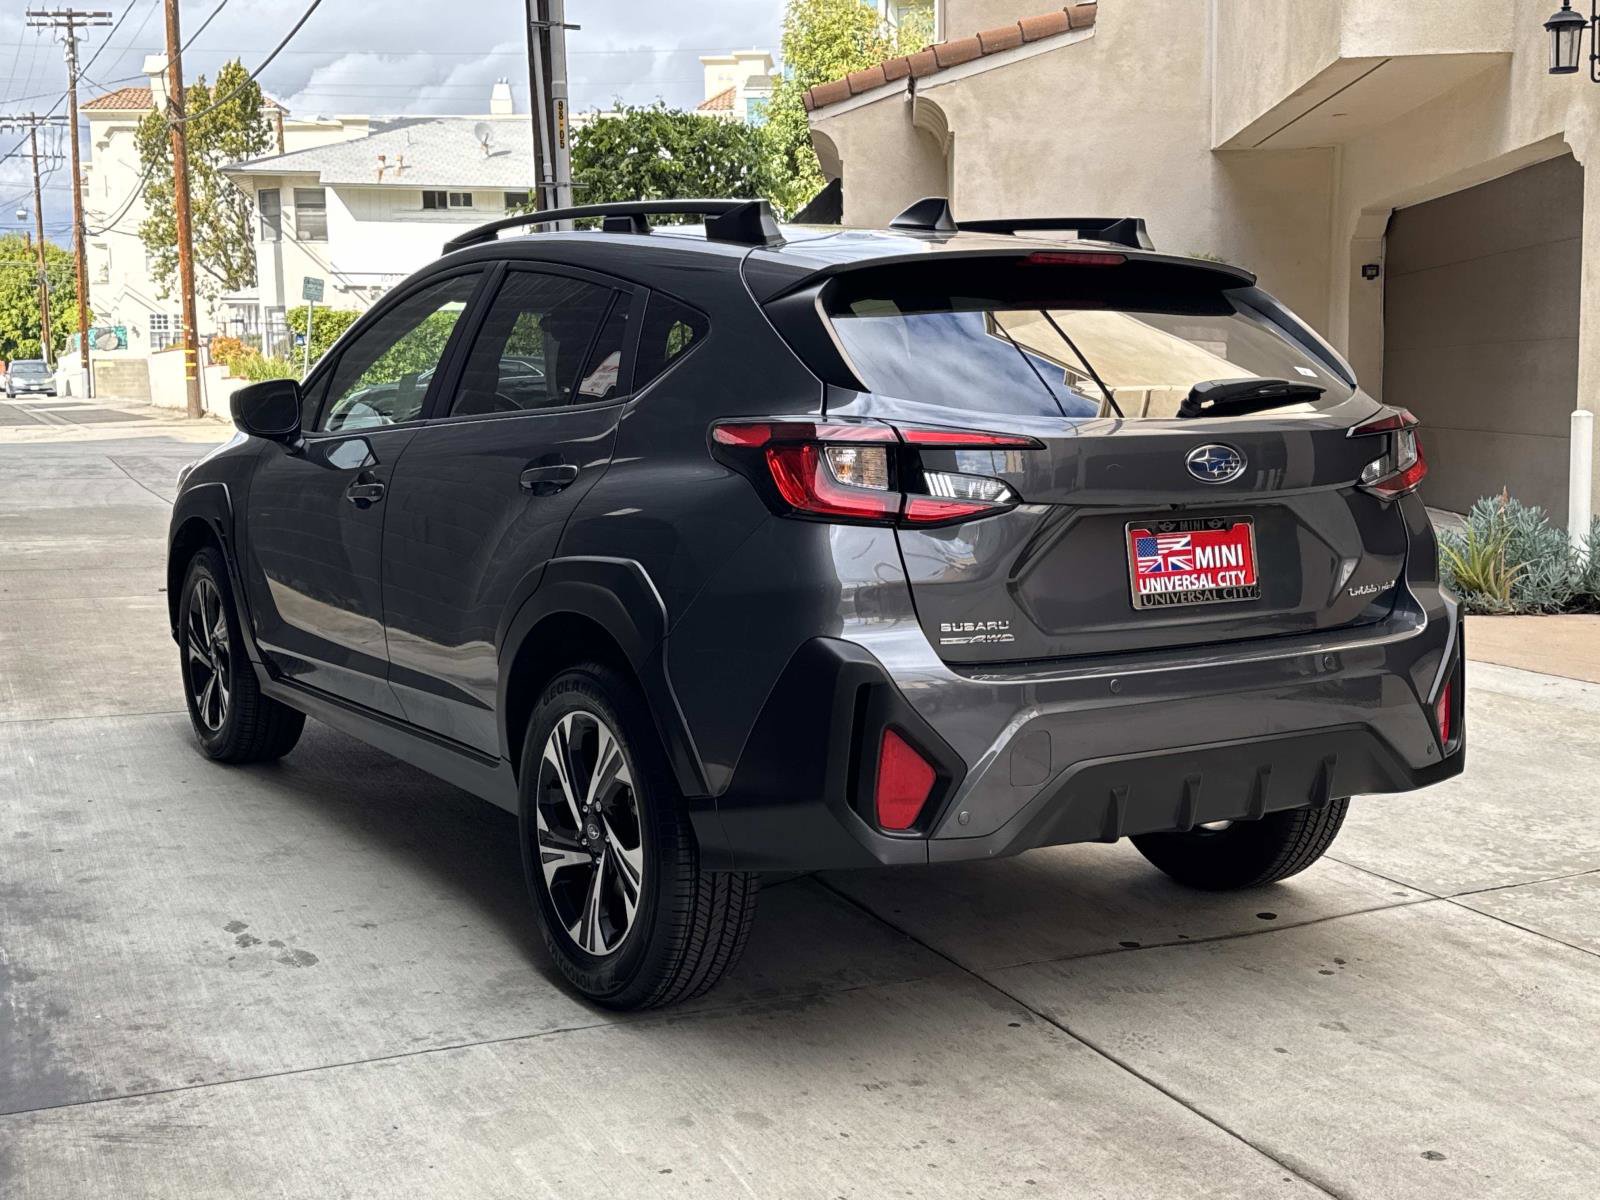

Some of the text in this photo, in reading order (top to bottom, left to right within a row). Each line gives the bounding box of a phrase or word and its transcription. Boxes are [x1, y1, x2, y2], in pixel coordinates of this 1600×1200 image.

[1179, 520, 1205, 531] MINI
[1195, 544, 1244, 569] MINI
[1139, 570, 1246, 593] UNIVERSAL CITY
[1142, 586, 1252, 606] UNIVERSAL CITY
[940, 620, 1009, 632] SUBARU
[969, 633, 1015, 643] AWD
